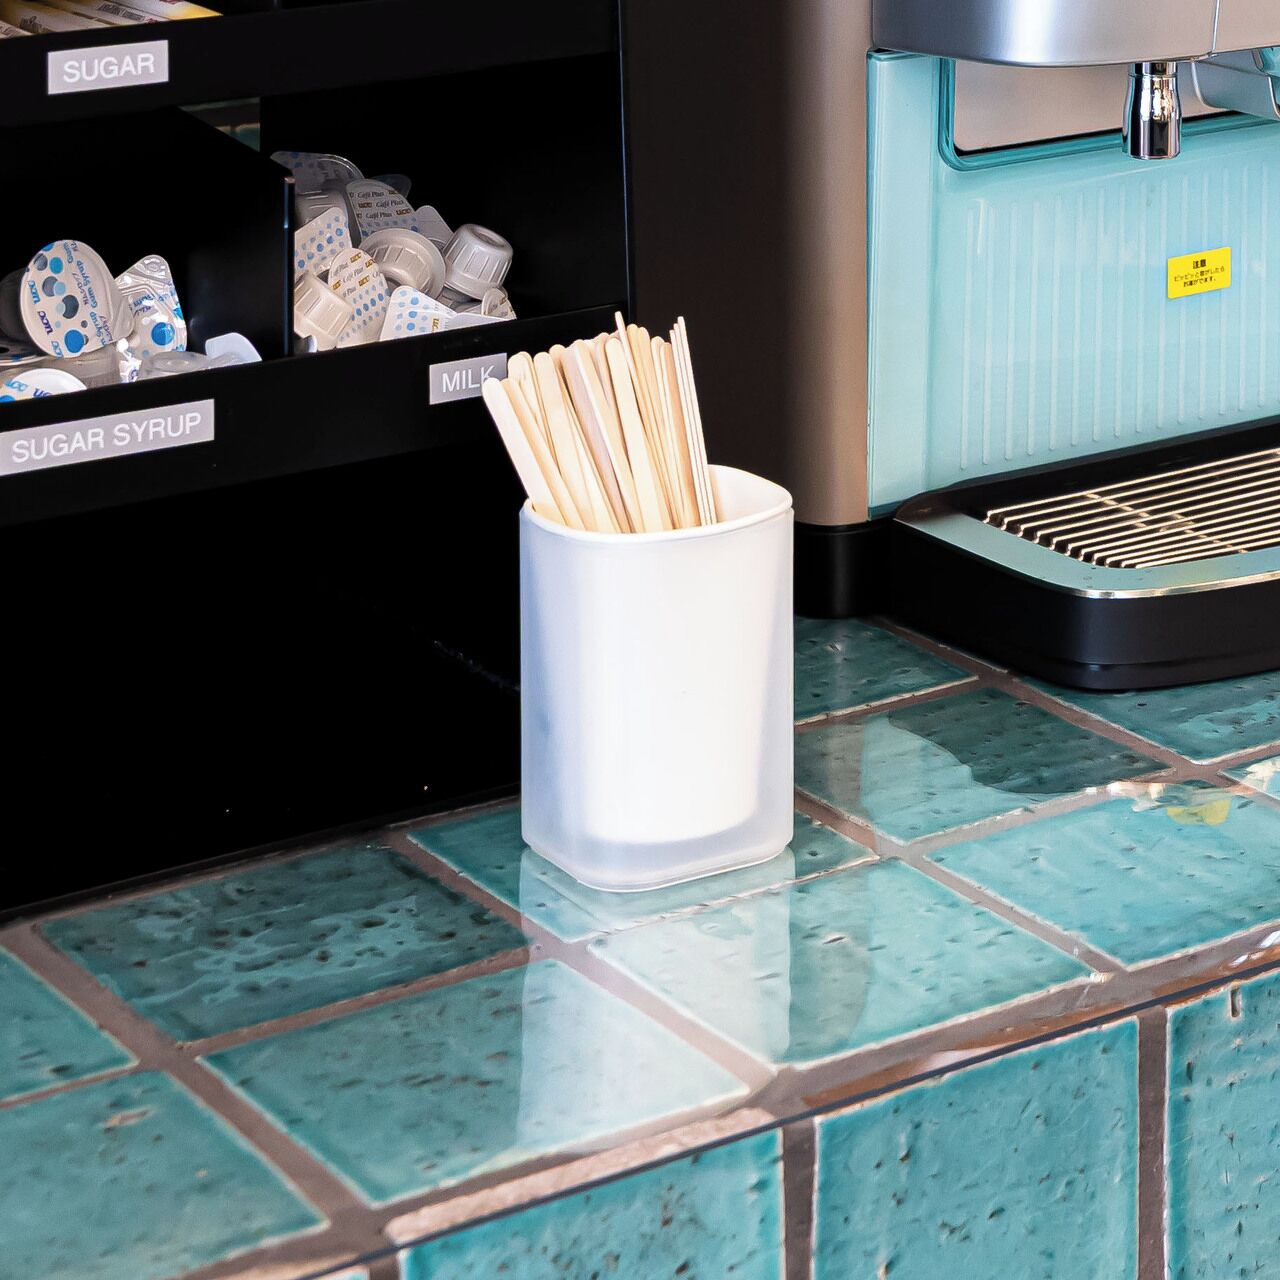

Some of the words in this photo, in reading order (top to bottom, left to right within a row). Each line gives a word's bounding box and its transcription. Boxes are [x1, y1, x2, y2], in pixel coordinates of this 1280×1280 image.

[63, 53, 155, 83] SUGAR
[12, 427, 105, 463] SUGAR
[113, 412, 201, 446] SYRUP
